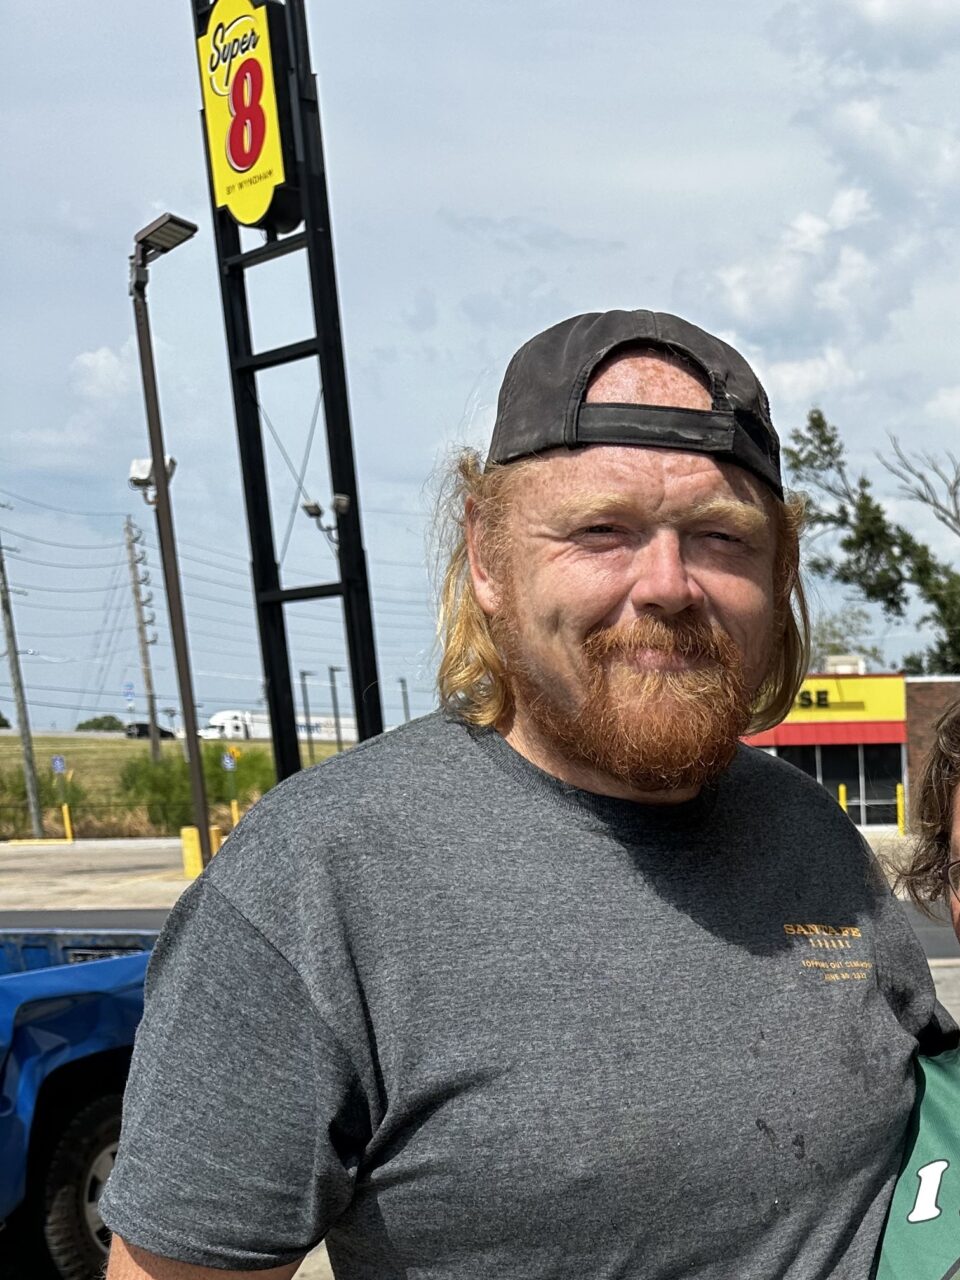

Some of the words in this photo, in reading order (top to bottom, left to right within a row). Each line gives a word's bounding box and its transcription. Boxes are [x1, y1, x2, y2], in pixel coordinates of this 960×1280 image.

[209, 15, 260, 90] Super
[226, 57, 267, 174] 8
[799, 690, 829, 708] SE
[783, 923, 840, 936] SANTA
[840, 926, 862, 938] FE
[906, 1158, 950, 1224] I
